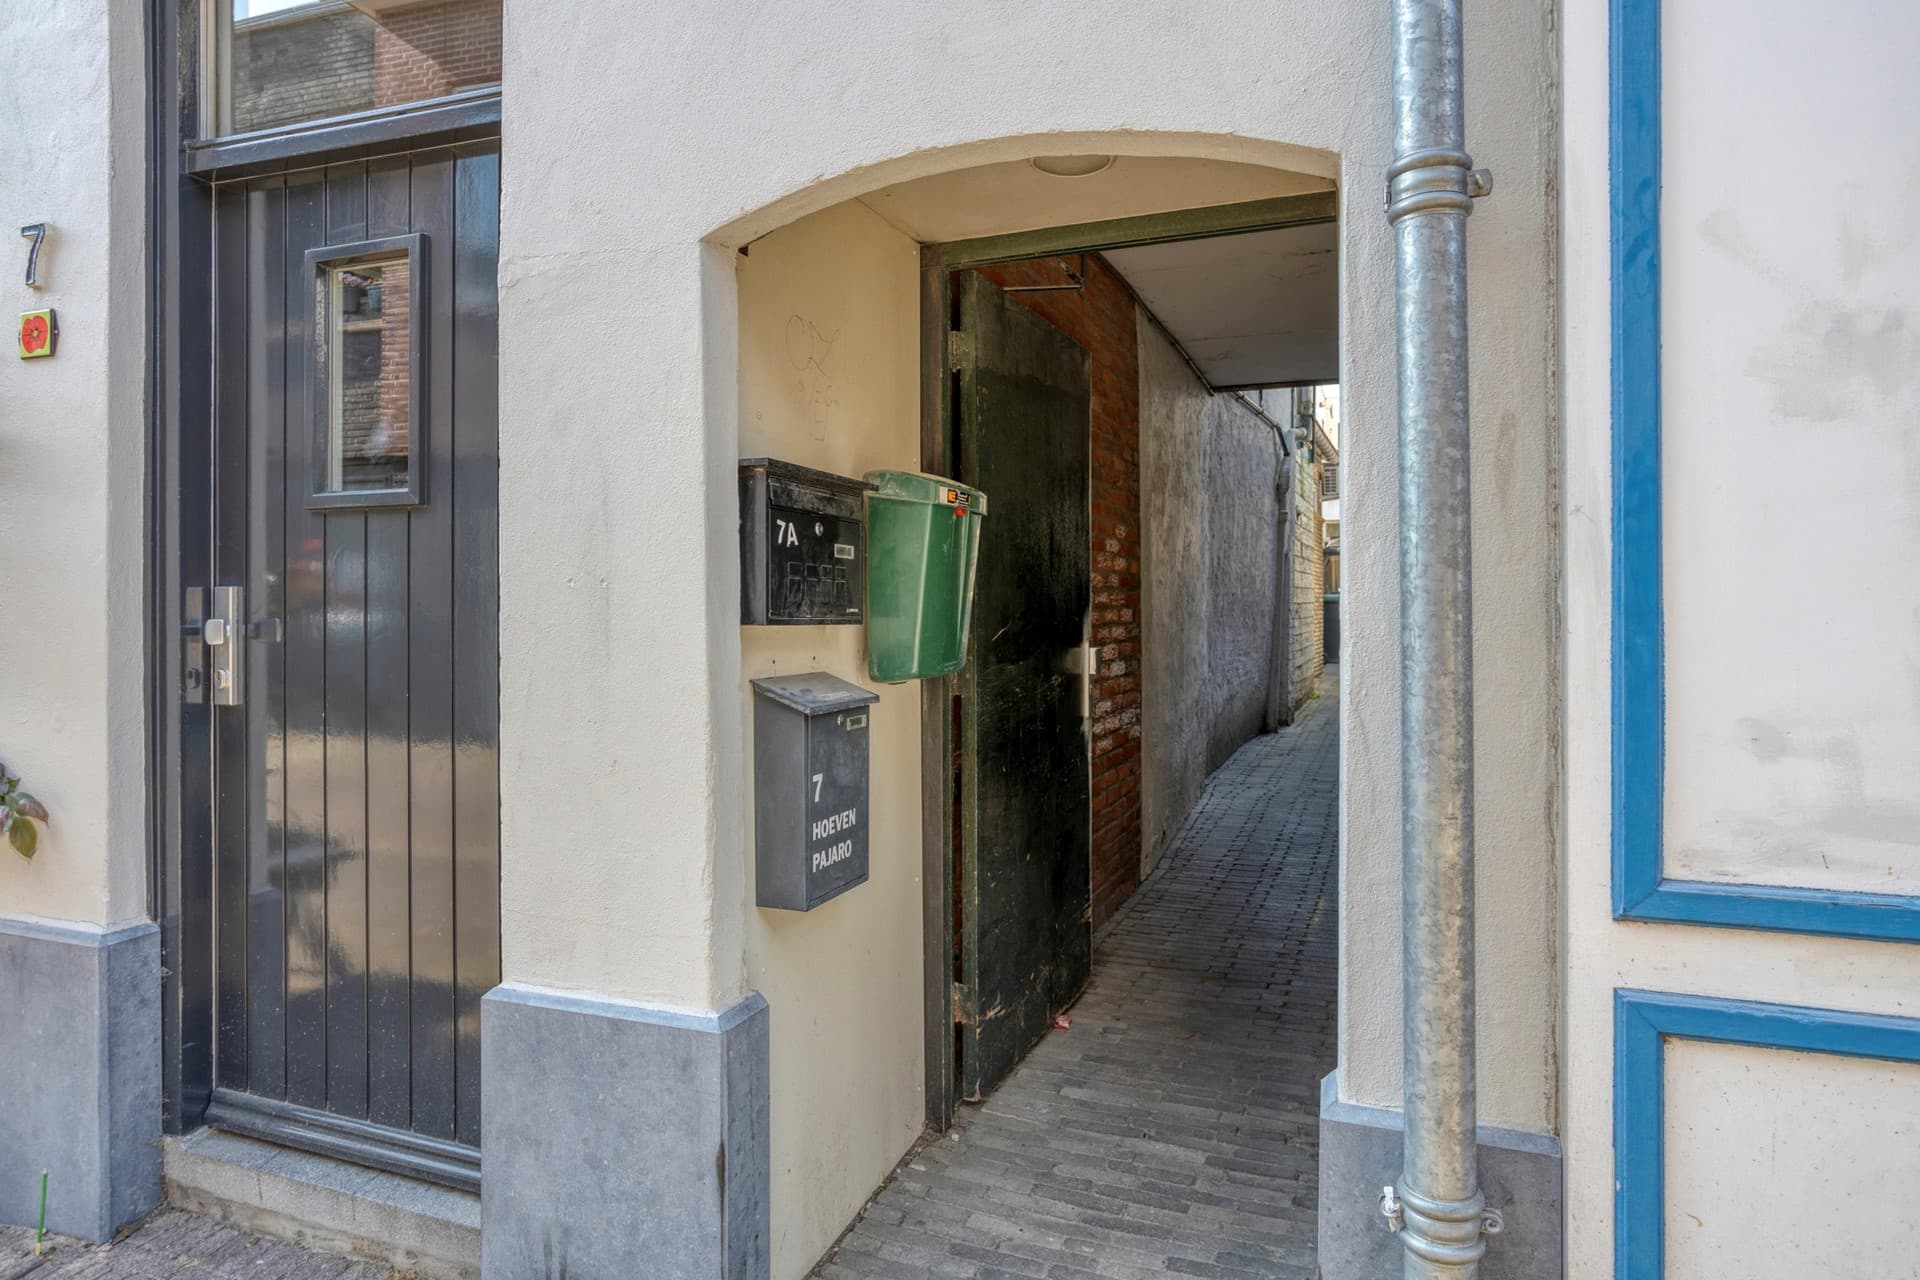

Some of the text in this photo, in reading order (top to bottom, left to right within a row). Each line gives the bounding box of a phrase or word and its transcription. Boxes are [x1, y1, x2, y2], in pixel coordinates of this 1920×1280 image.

[21, 223, 45, 286] 7
[776, 519, 799, 548] 7A
[812, 773, 824, 803] 7
[812, 808, 857, 841] HOEVEN
[812, 839, 852, 873] PAJARO
